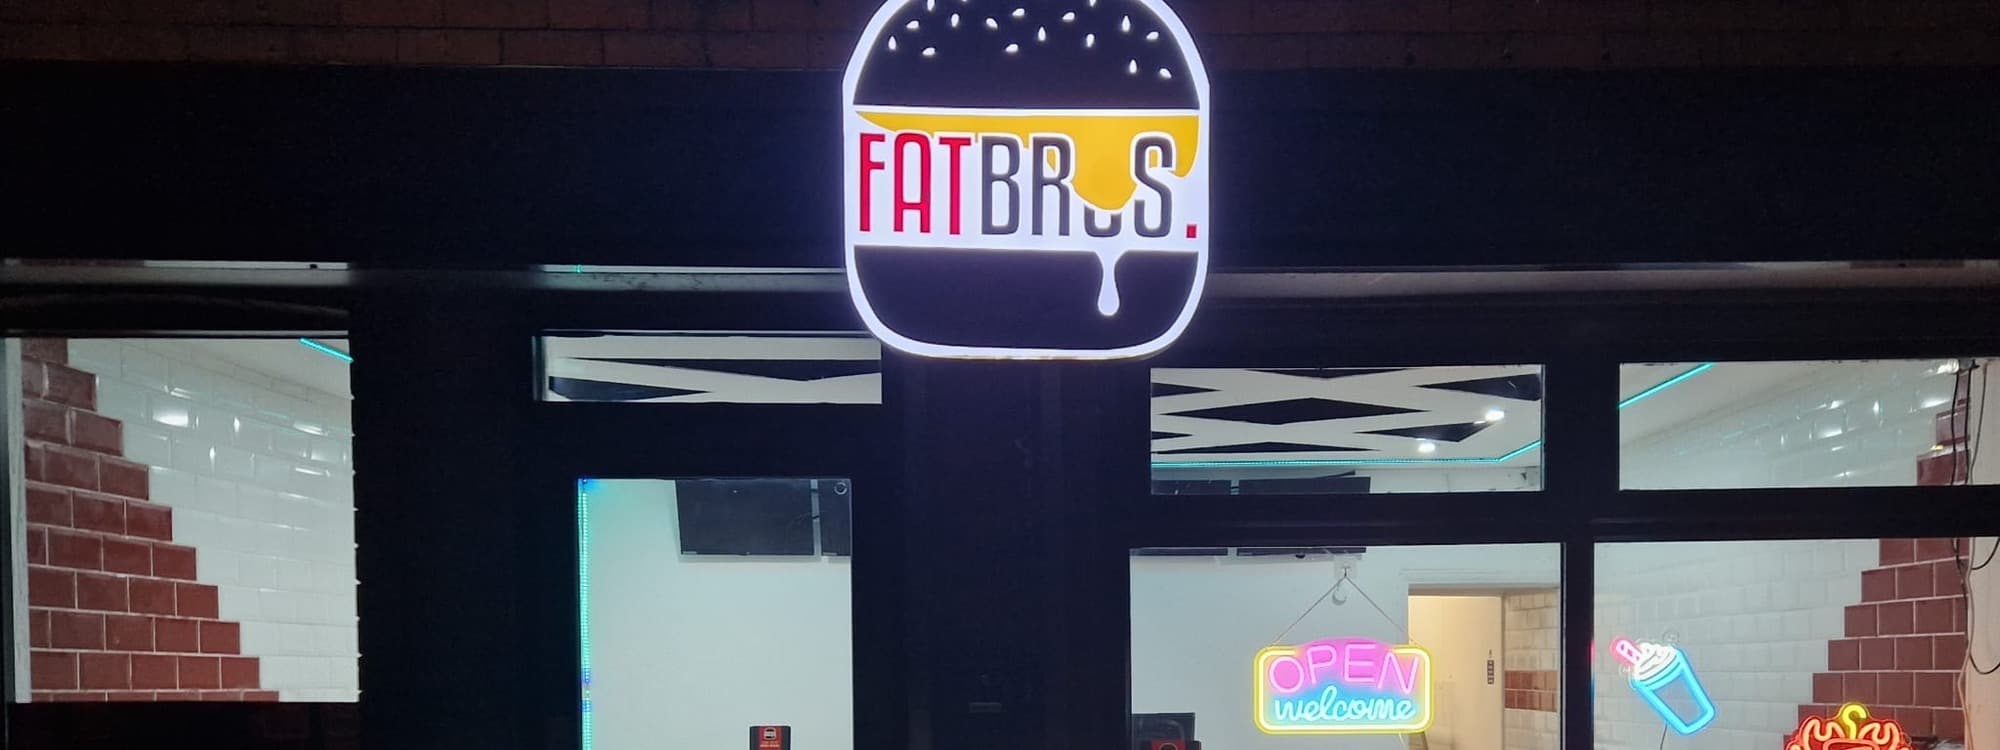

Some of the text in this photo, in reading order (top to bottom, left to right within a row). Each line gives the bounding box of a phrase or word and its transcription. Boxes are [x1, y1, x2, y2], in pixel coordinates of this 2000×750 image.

[859, 133, 1197, 238] FATBRS.
[1269, 643, 1419, 694] OPEN
[1274, 685, 1417, 722] welcome
